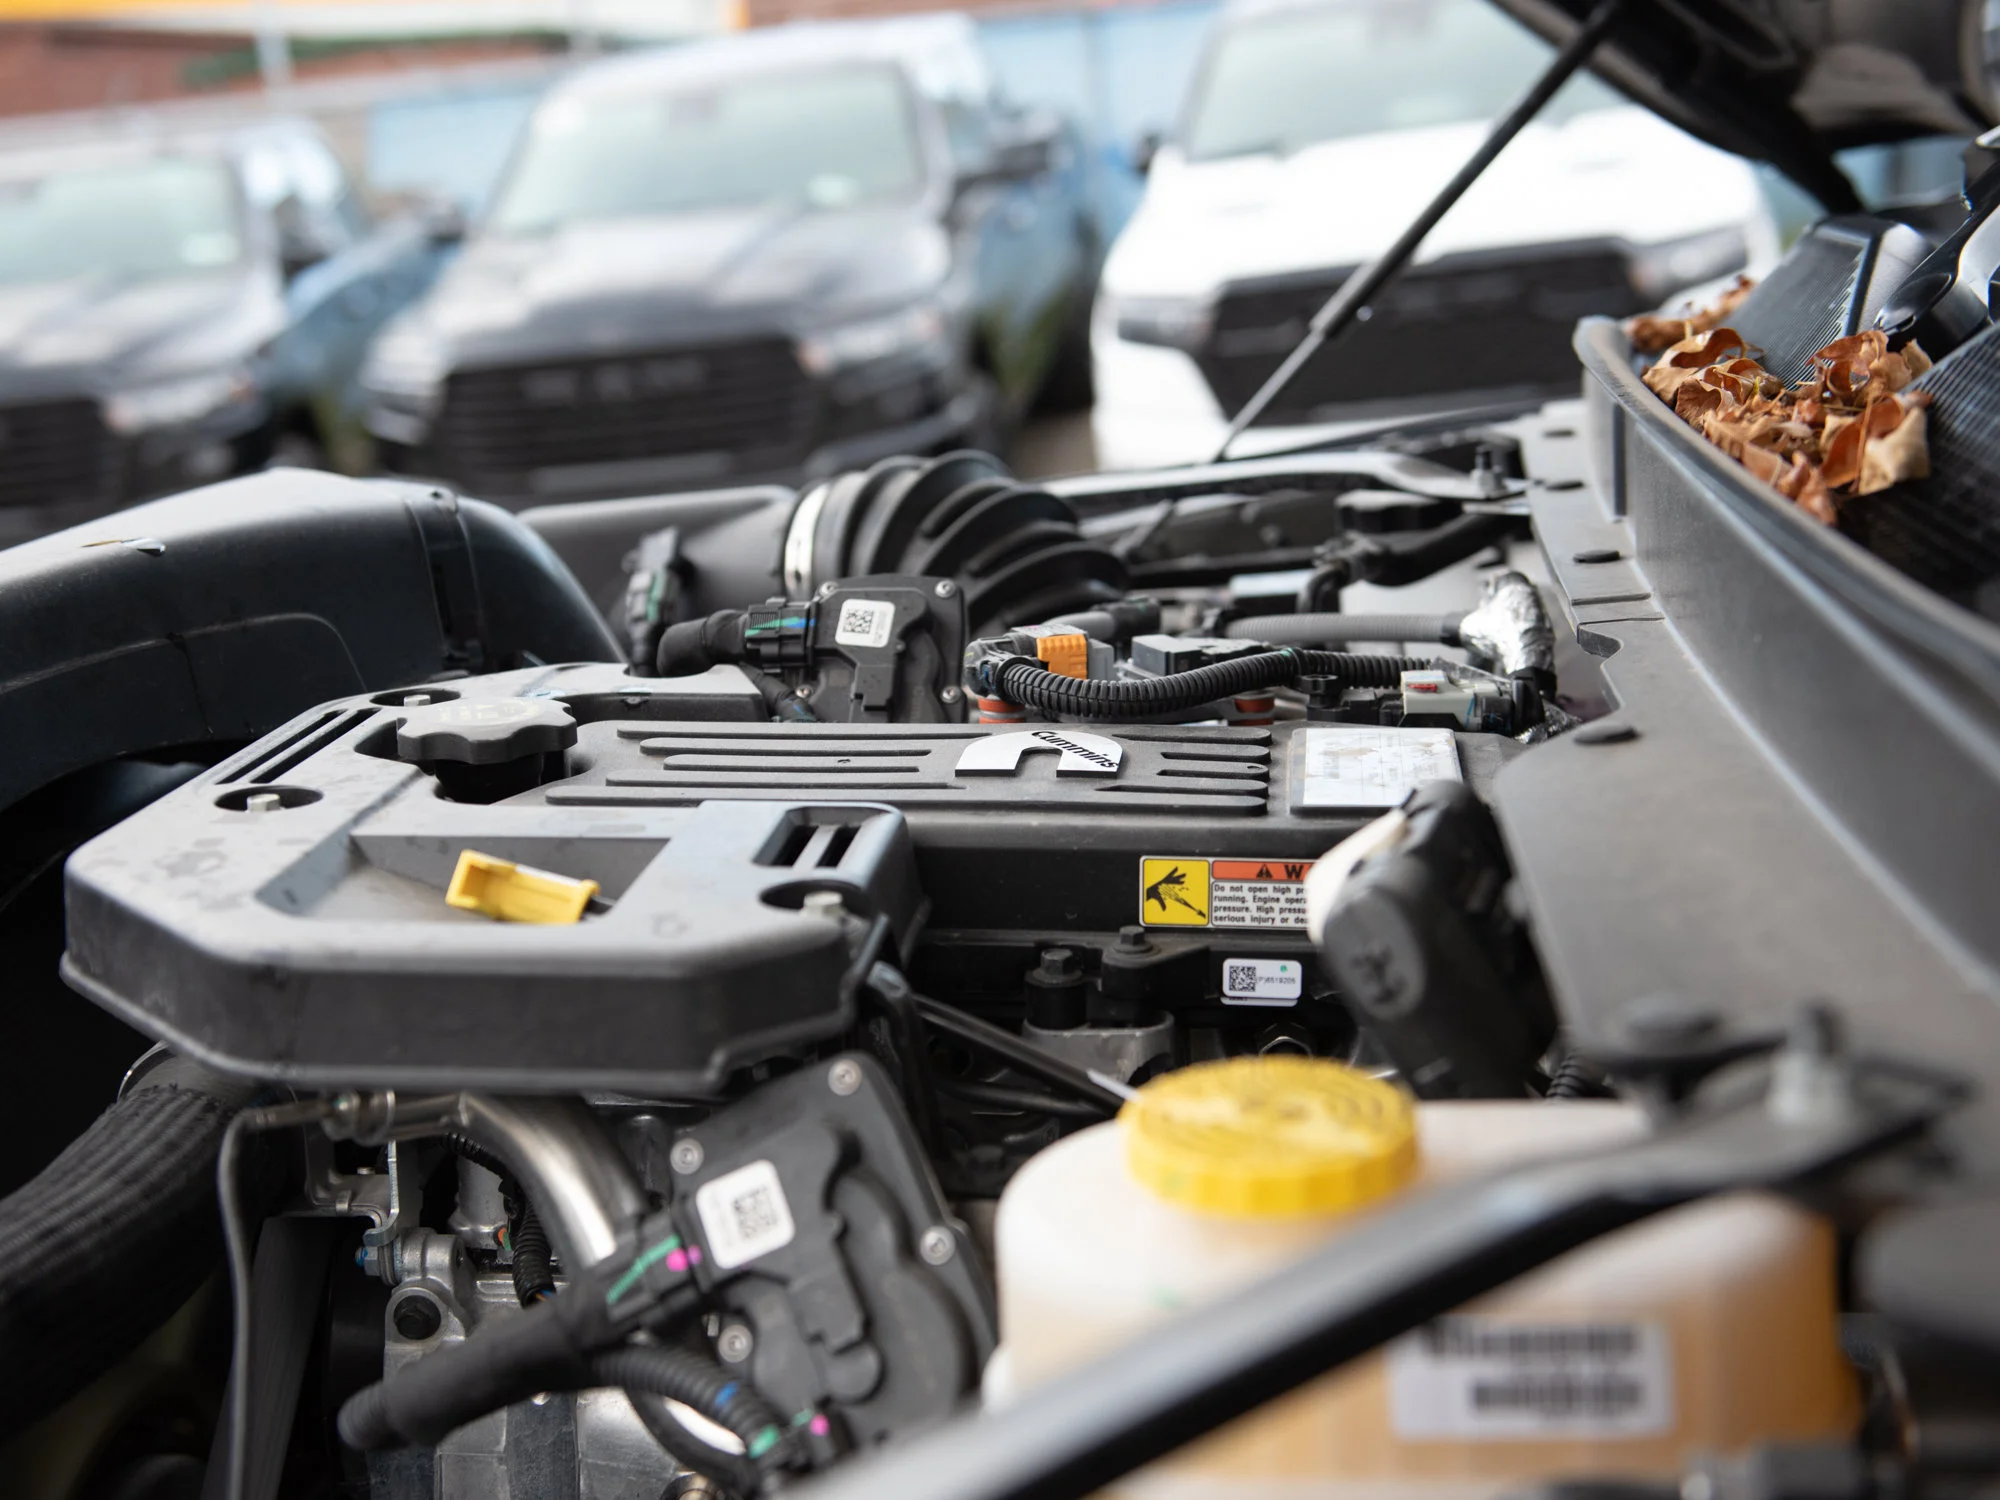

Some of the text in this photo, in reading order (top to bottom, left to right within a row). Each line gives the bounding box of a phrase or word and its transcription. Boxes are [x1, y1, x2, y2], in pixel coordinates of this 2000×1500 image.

[1031, 730, 1119, 768] Cummins
[1214, 884, 1225, 893] Do
[1229, 885, 1243, 893] not
[1247, 886, 1268, 894] open
[1273, 886, 1291, 895] high
[1214, 895, 1248, 904] running.
[1253, 896, 1280, 904] Engine
[1214, 905, 1306, 916] pressure. High pressu
[1214, 915, 1246, 923] serious
[1250, 915, 1276, 925] injury
